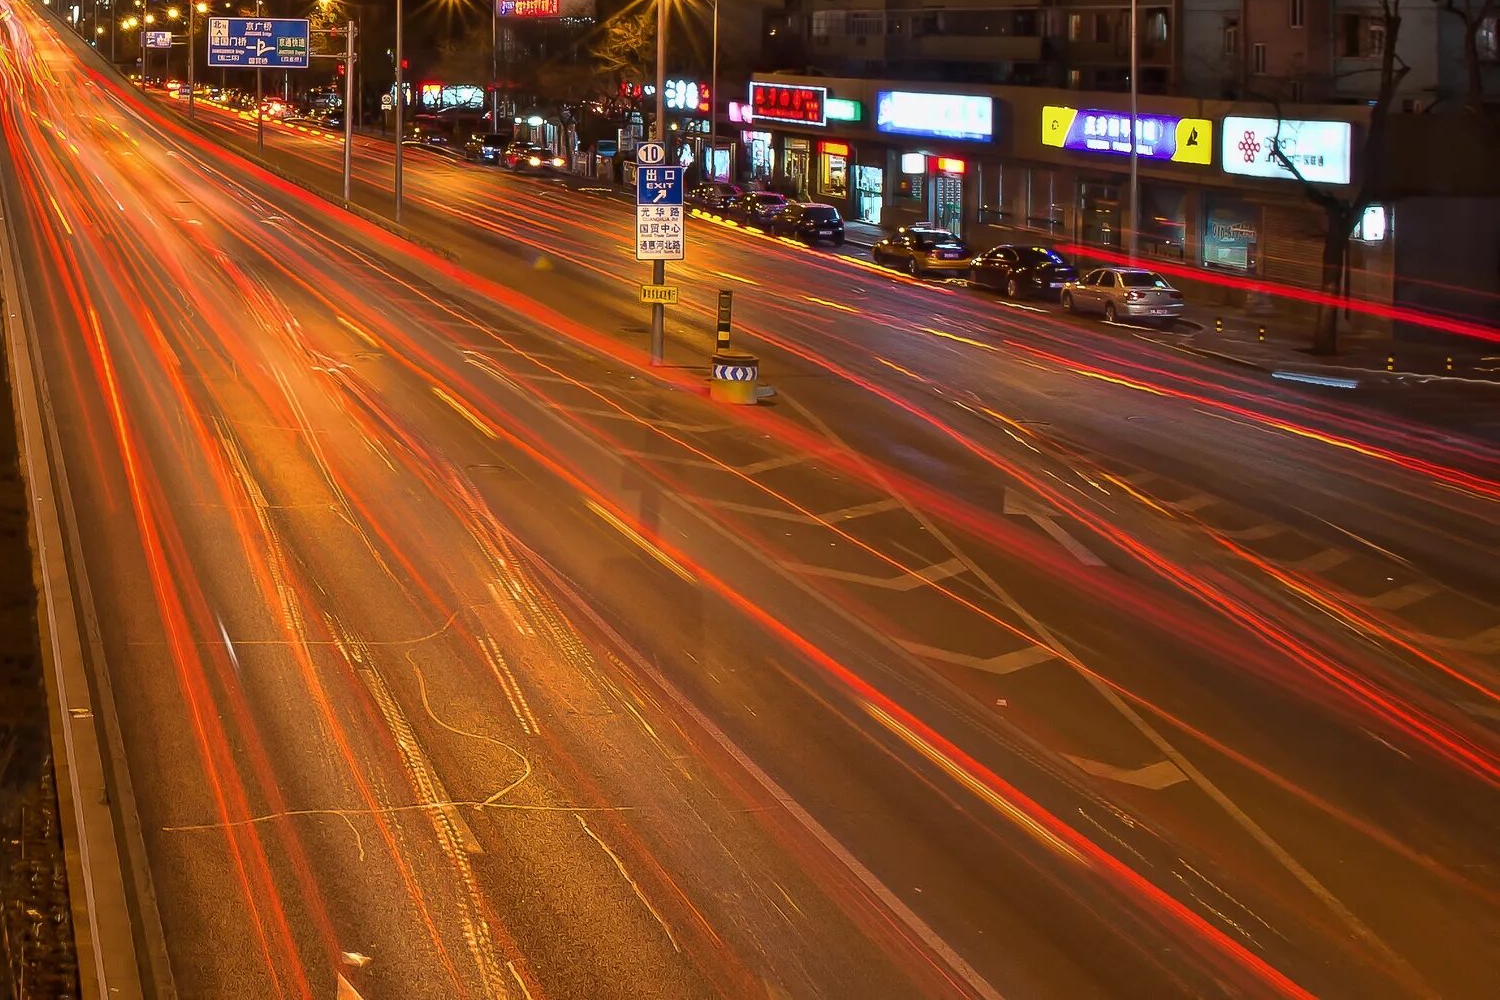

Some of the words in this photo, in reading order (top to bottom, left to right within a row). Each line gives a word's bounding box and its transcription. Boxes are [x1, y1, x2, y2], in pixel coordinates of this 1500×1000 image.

[245, 22, 272, 31] 京广桥
[643, 146, 659, 161] 10
[646, 169, 675, 181] 出口
[641, 207, 680, 217] 光华路
[640, 224, 681, 233] 国贸中心
[640, 240, 681, 250] 通惠河北路
